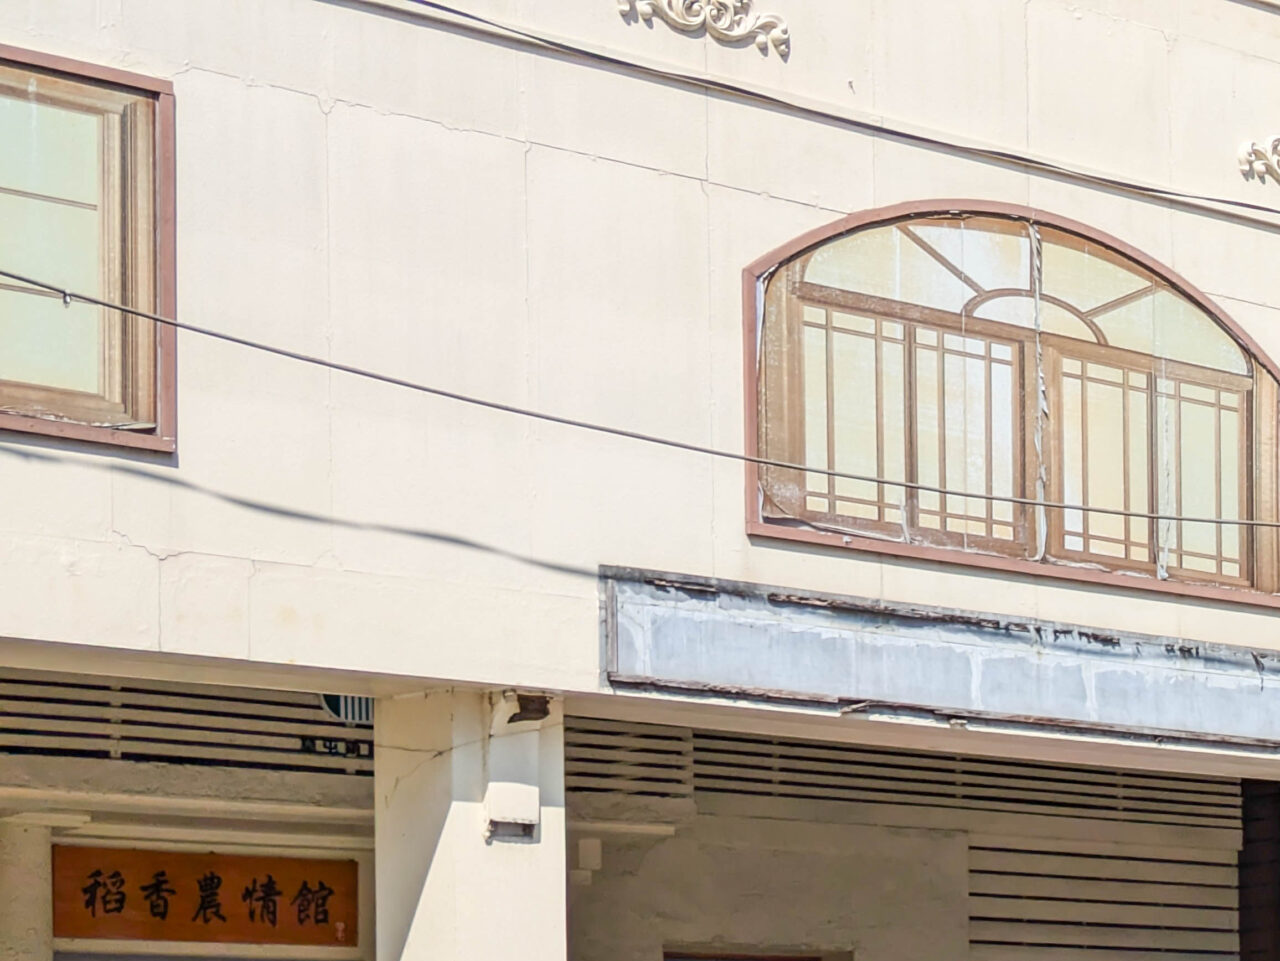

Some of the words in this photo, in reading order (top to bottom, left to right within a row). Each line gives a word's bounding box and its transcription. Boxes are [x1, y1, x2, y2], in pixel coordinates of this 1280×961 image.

[81, 868, 335, 928] 稻香農情館
